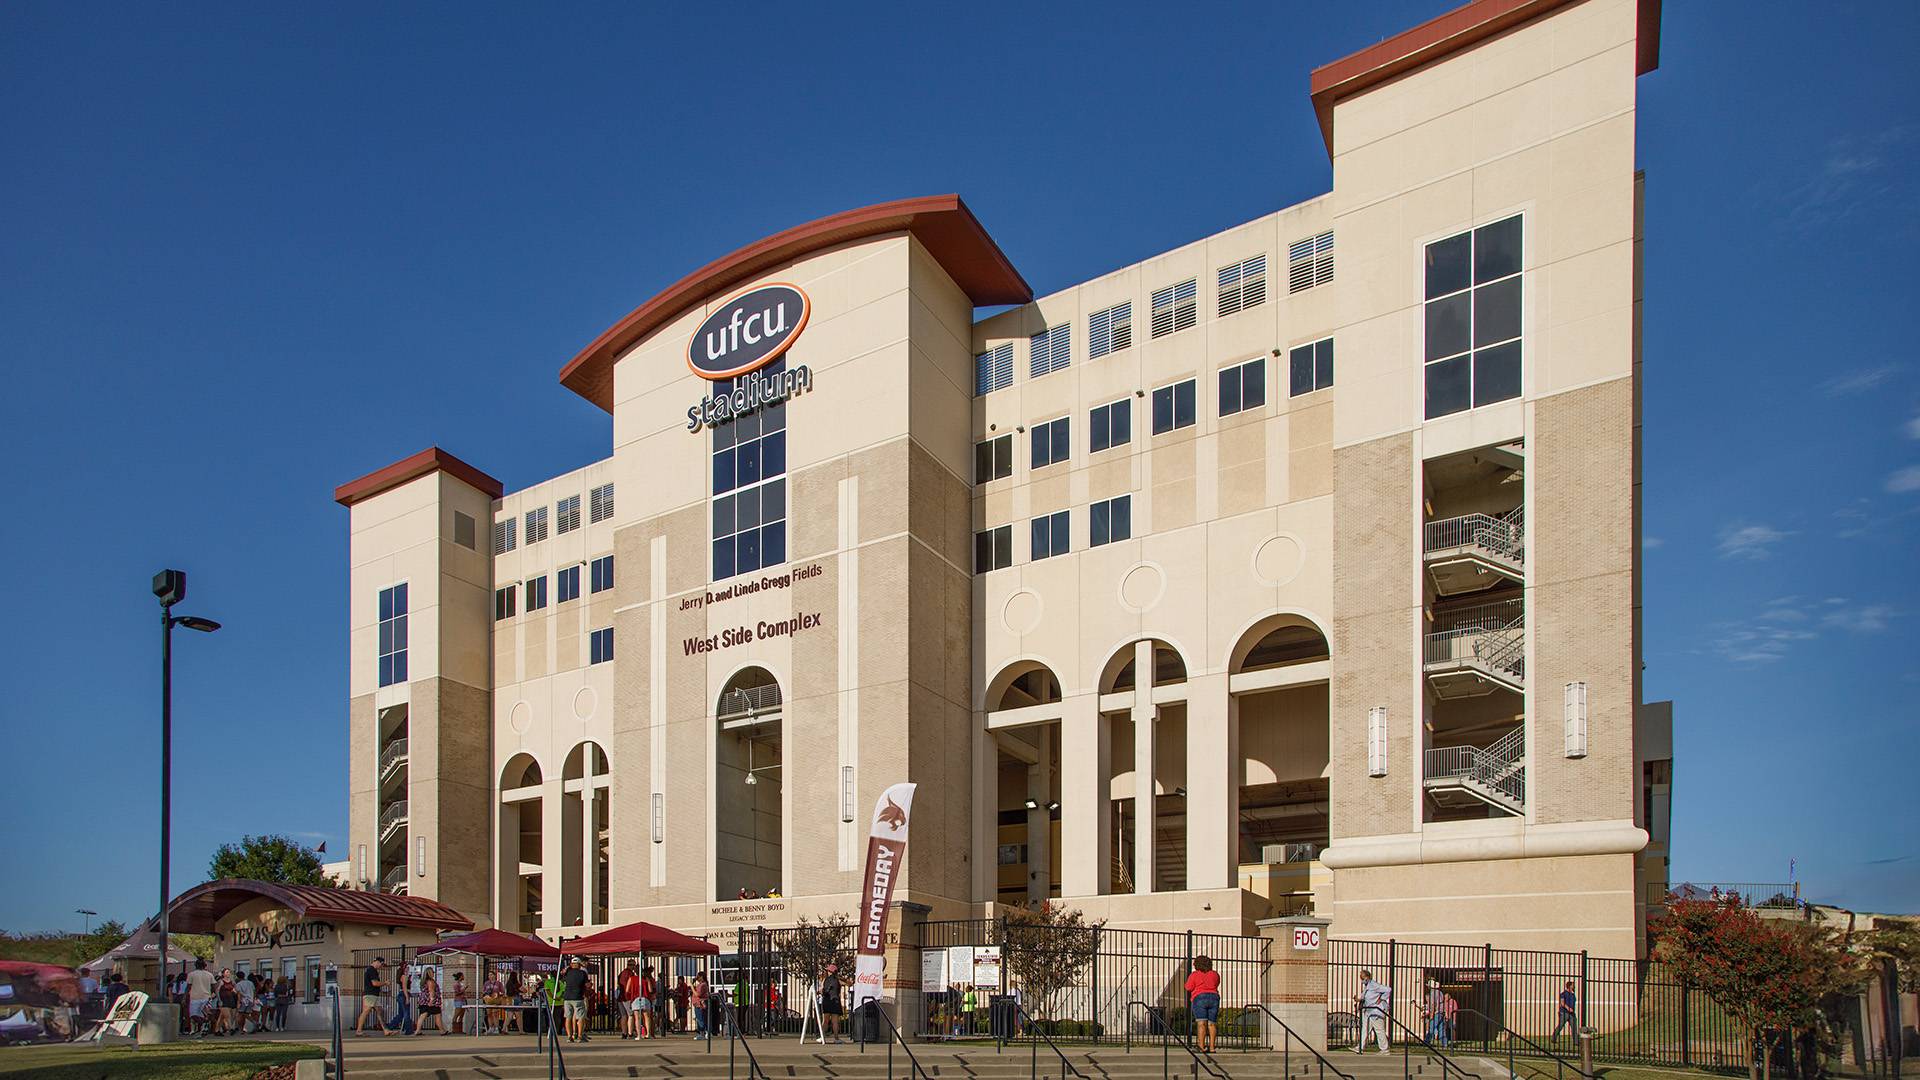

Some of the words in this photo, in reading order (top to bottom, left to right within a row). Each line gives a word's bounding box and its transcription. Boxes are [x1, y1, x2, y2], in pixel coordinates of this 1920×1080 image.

[706, 302, 785, 361] ufcu
[686, 363, 812, 433] stadium
[679, 597, 703, 612] Jerry
[715, 586, 733, 602] and
[733, 580, 760, 598] Linda
[760, 573, 790, 591] Gregg
[792, 563, 823, 582] Fields
[683, 634, 719, 656] West
[721, 626, 753, 648] Side
[757, 611, 821, 641] Complex
[711, 906, 738, 915] MICHELE
[745, 904, 766, 913] BENNY
[767, 903, 785, 911] BOYD
[866, 844, 896, 949] GAMEDAY
[231, 926, 269, 946] TEXAS
[284, 922, 325, 942] STATE
[729, 914, 748, 922] LEGACY
[1294, 930, 1319, 947] FDC
[537, 963, 560, 972] TEXA
